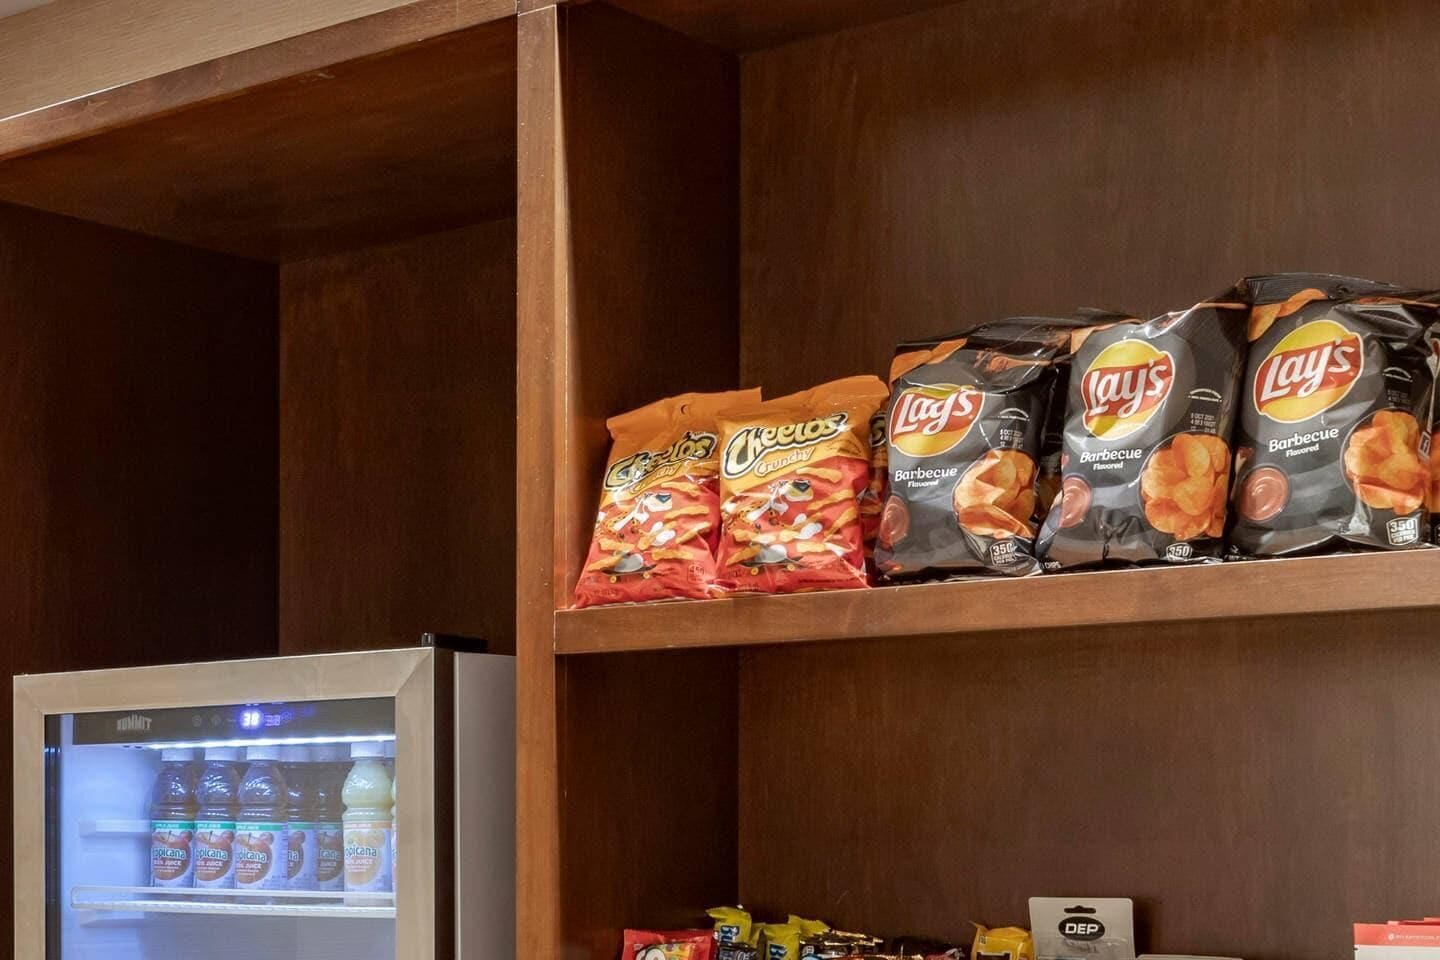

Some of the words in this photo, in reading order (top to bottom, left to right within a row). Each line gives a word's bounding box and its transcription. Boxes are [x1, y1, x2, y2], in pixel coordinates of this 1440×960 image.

[1260, 338, 1355, 400] Lay's
[1088, 359, 1167, 418] Lay's
[726, 414, 847, 477] Cheetos
[1269, 426, 1339, 453] Barbecue
[1079, 447, 1142, 464] Barbecue
[1285, 443, 1319, 457] Flavored
[755, 447, 814, 476] Crunchy
[1092, 460, 1123, 471] Flavored
[894, 466, 958, 482] Barbecue
[907, 478, 939, 488] Flavored
[1390, 519, 1414, 533] 350
[1169, 546, 1190, 558] 350
[242, 711, 258, 728] 38
[1065, 924, 1099, 936] DEP
